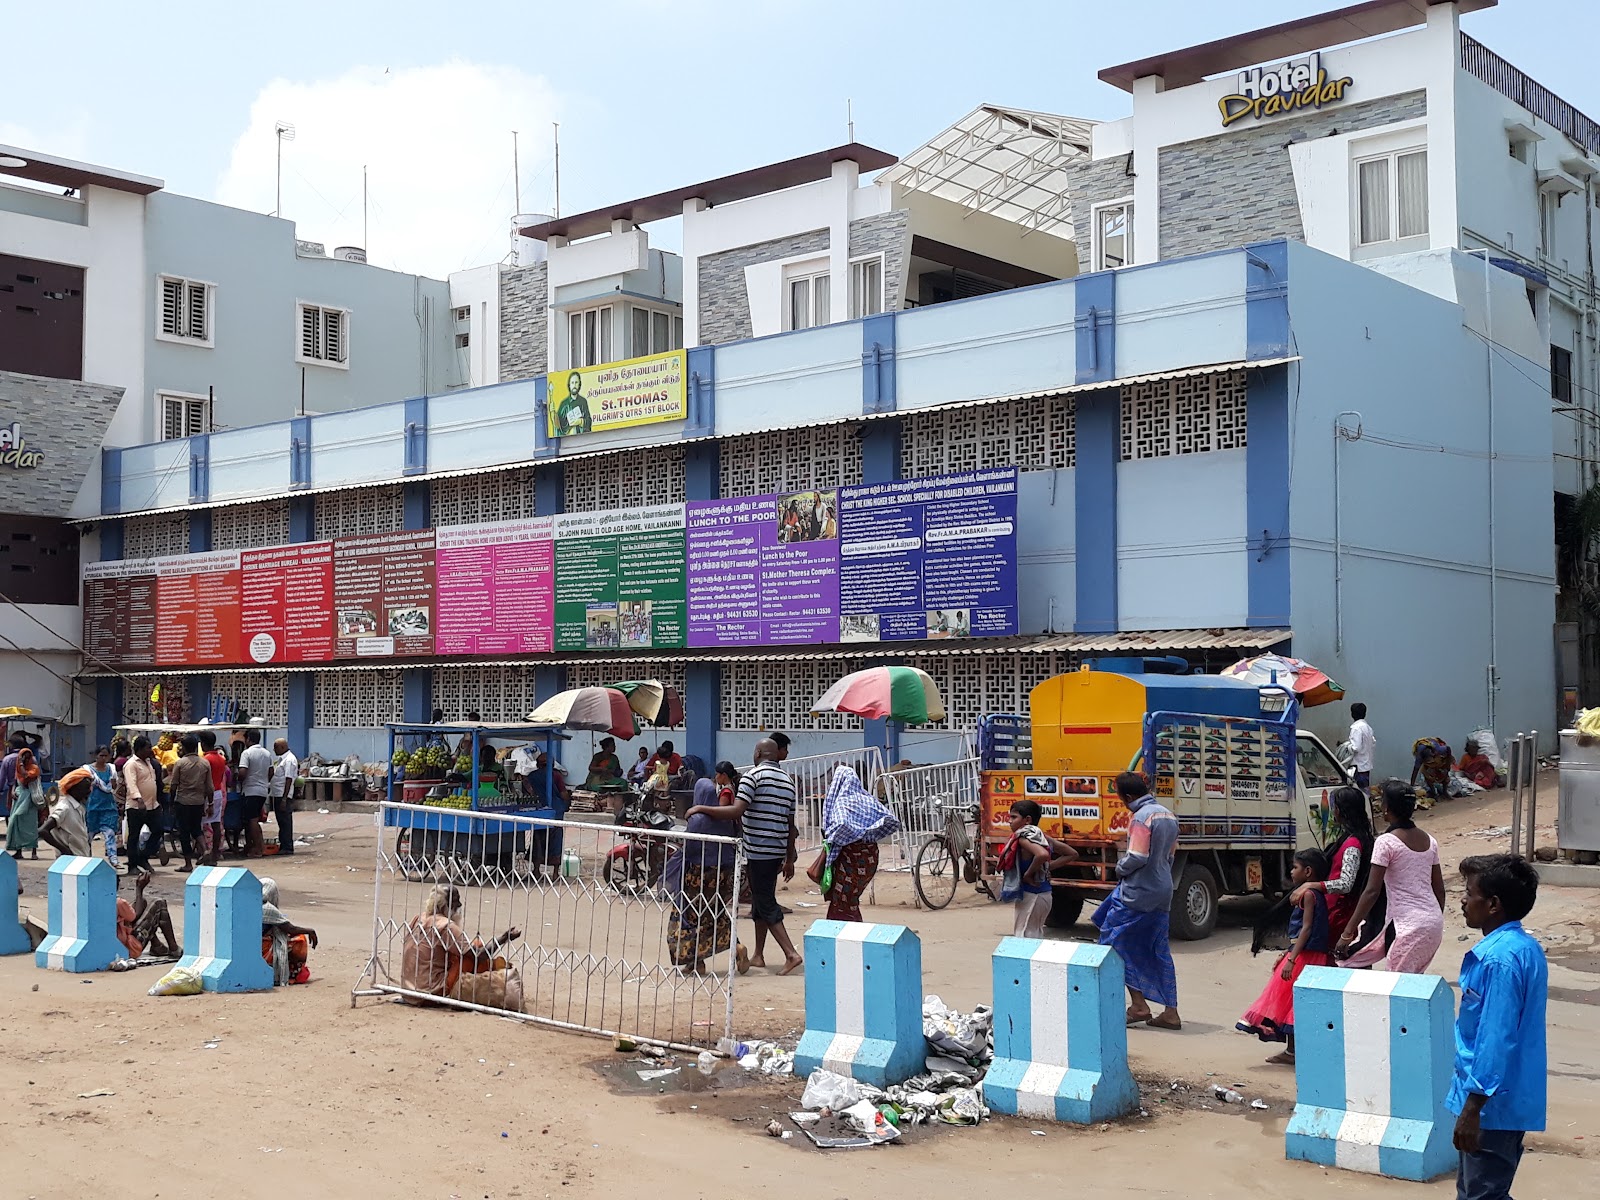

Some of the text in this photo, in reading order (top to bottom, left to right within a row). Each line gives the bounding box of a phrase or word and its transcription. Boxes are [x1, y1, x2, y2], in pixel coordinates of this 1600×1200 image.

[1238, 52, 1320, 99] Hotel
[1218, 68, 1353, 127] Dravidar
[598, 370, 618, 384] புனித
[626, 408, 642, 418] QTRS
[644, 406, 656, 414] 1ST
[658, 402, 679, 412] BLOCK
[0, 422, 20, 450] el
[897, 494, 913, 504] SCHOOL
[935, 490, 943, 499] FOR
[943, 488, 963, 498] DISABLED
[734, 502, 750, 513] மதிய
[752, 501, 775, 510] உணவு
[644, 520, 682, 530] VAILANKANNI
[689, 512, 776, 527] LUNCH TO THE POOR
[788, 569, 810, 577] Theresa
[1064, 808, 1097, 817] HORN
